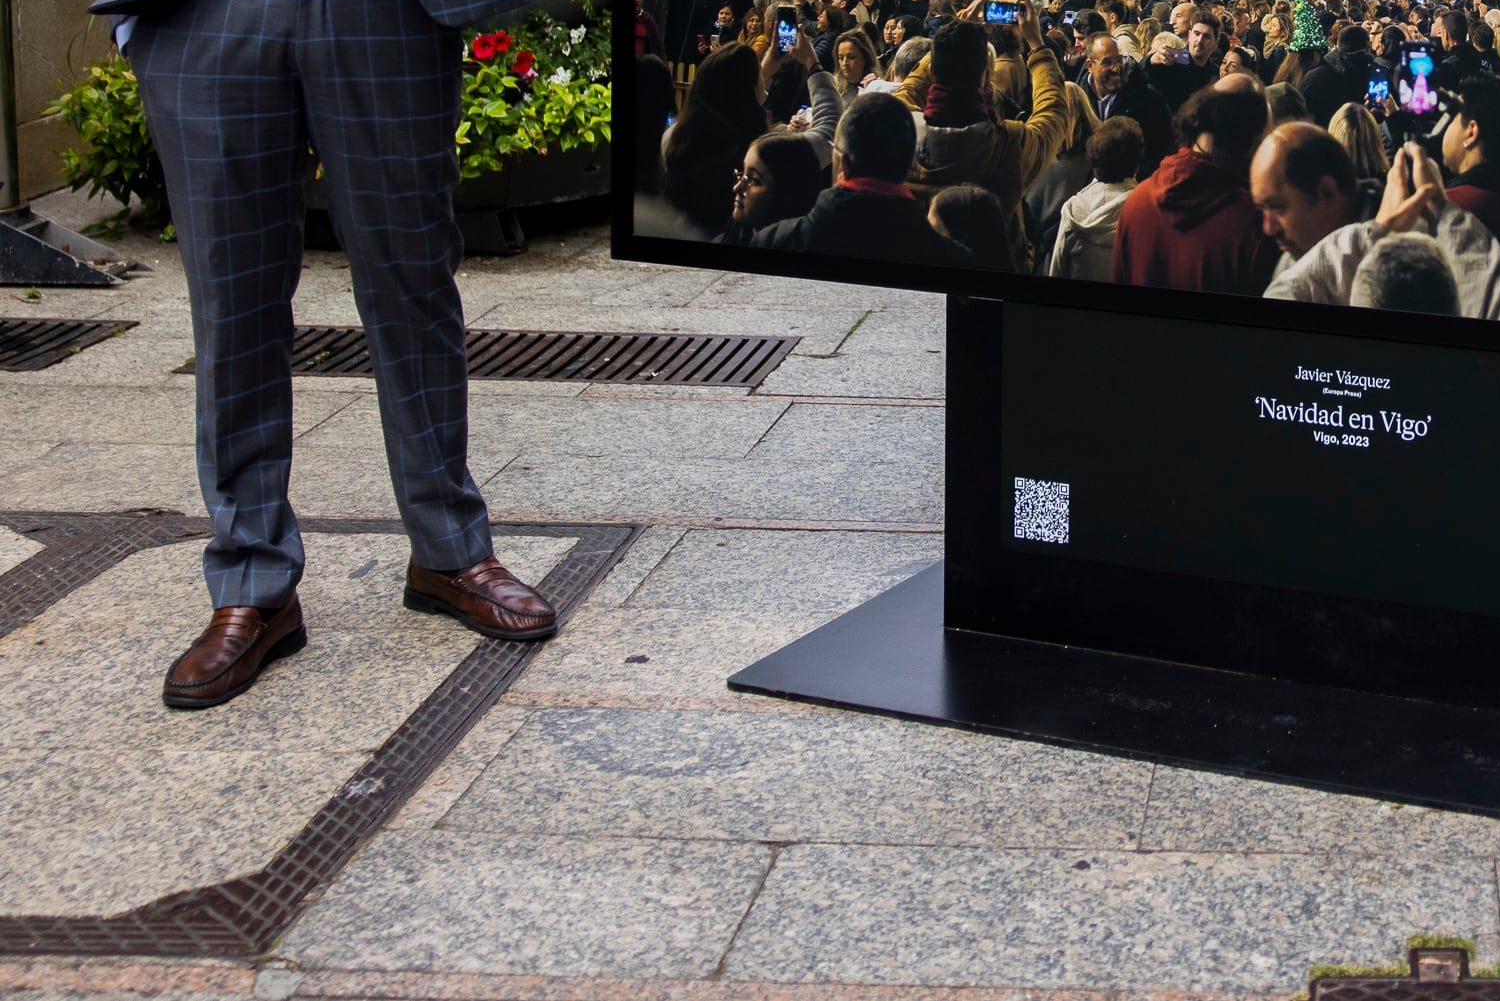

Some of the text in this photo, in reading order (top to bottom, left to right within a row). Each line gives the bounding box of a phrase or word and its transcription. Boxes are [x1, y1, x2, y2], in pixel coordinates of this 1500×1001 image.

[1295, 366, 1391, 390] Javier Vázquez
[1322, 387, 1362, 398] (Europa Press)
[1349, 412, 1374, 431] en
[1313, 431, 1370, 447] Vigo, 2023
